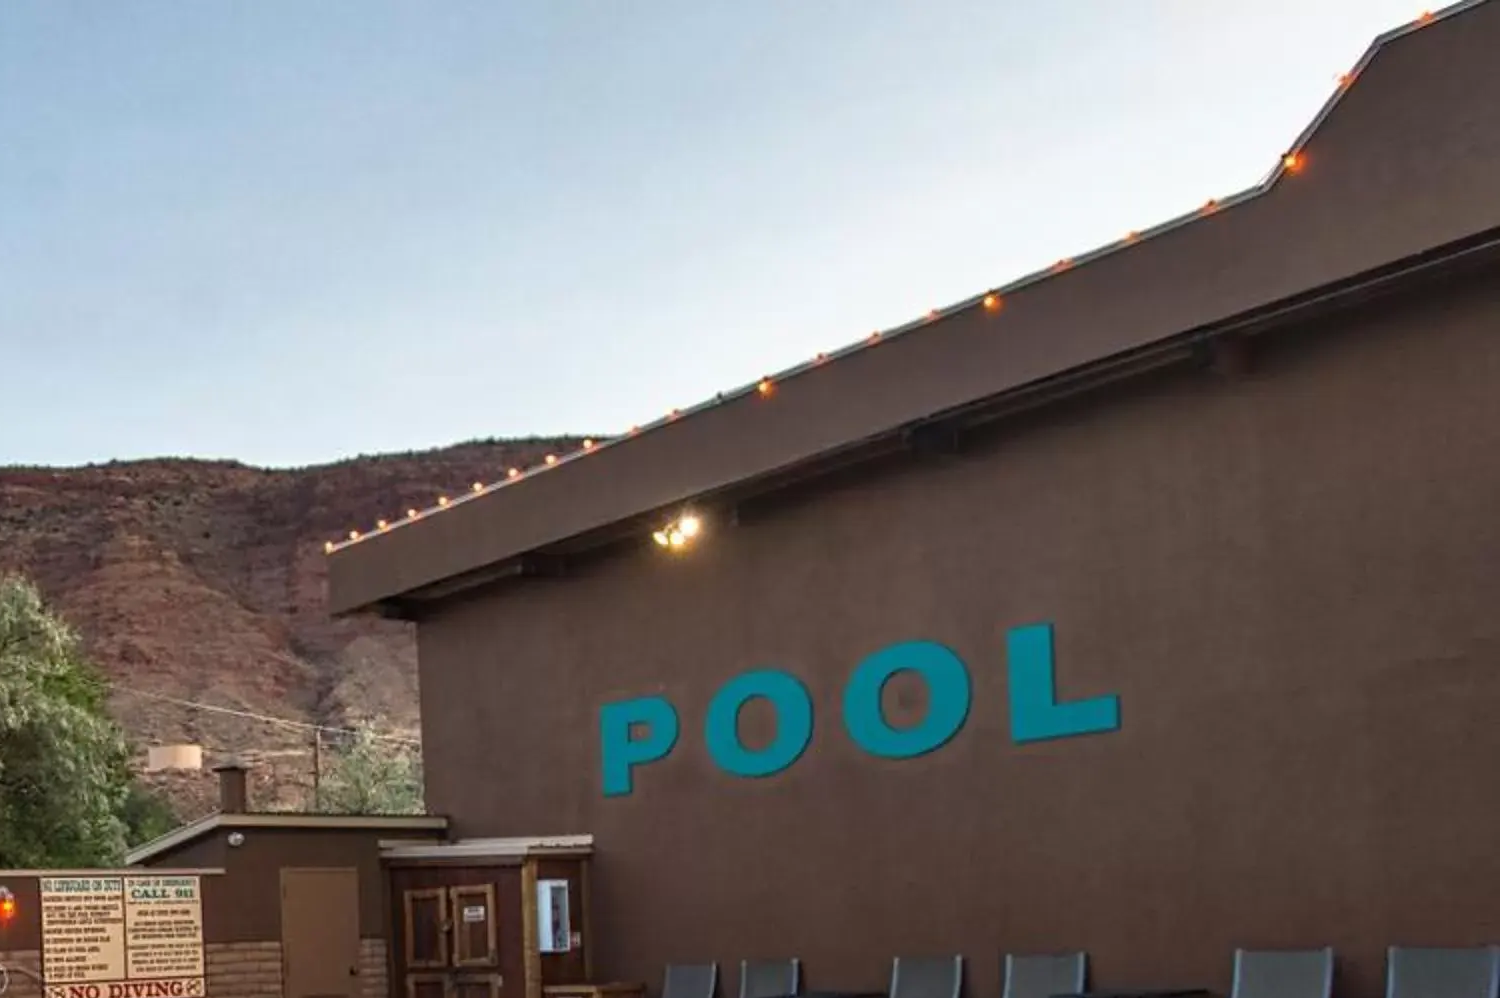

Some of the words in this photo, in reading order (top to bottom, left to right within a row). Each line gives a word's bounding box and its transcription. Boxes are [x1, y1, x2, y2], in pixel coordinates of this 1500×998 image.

[599, 620, 1122, 798] POOL
[131, 889, 170, 898] CALL
[175, 889, 194, 898] 911
[108, 982, 183, 998] DIVING
